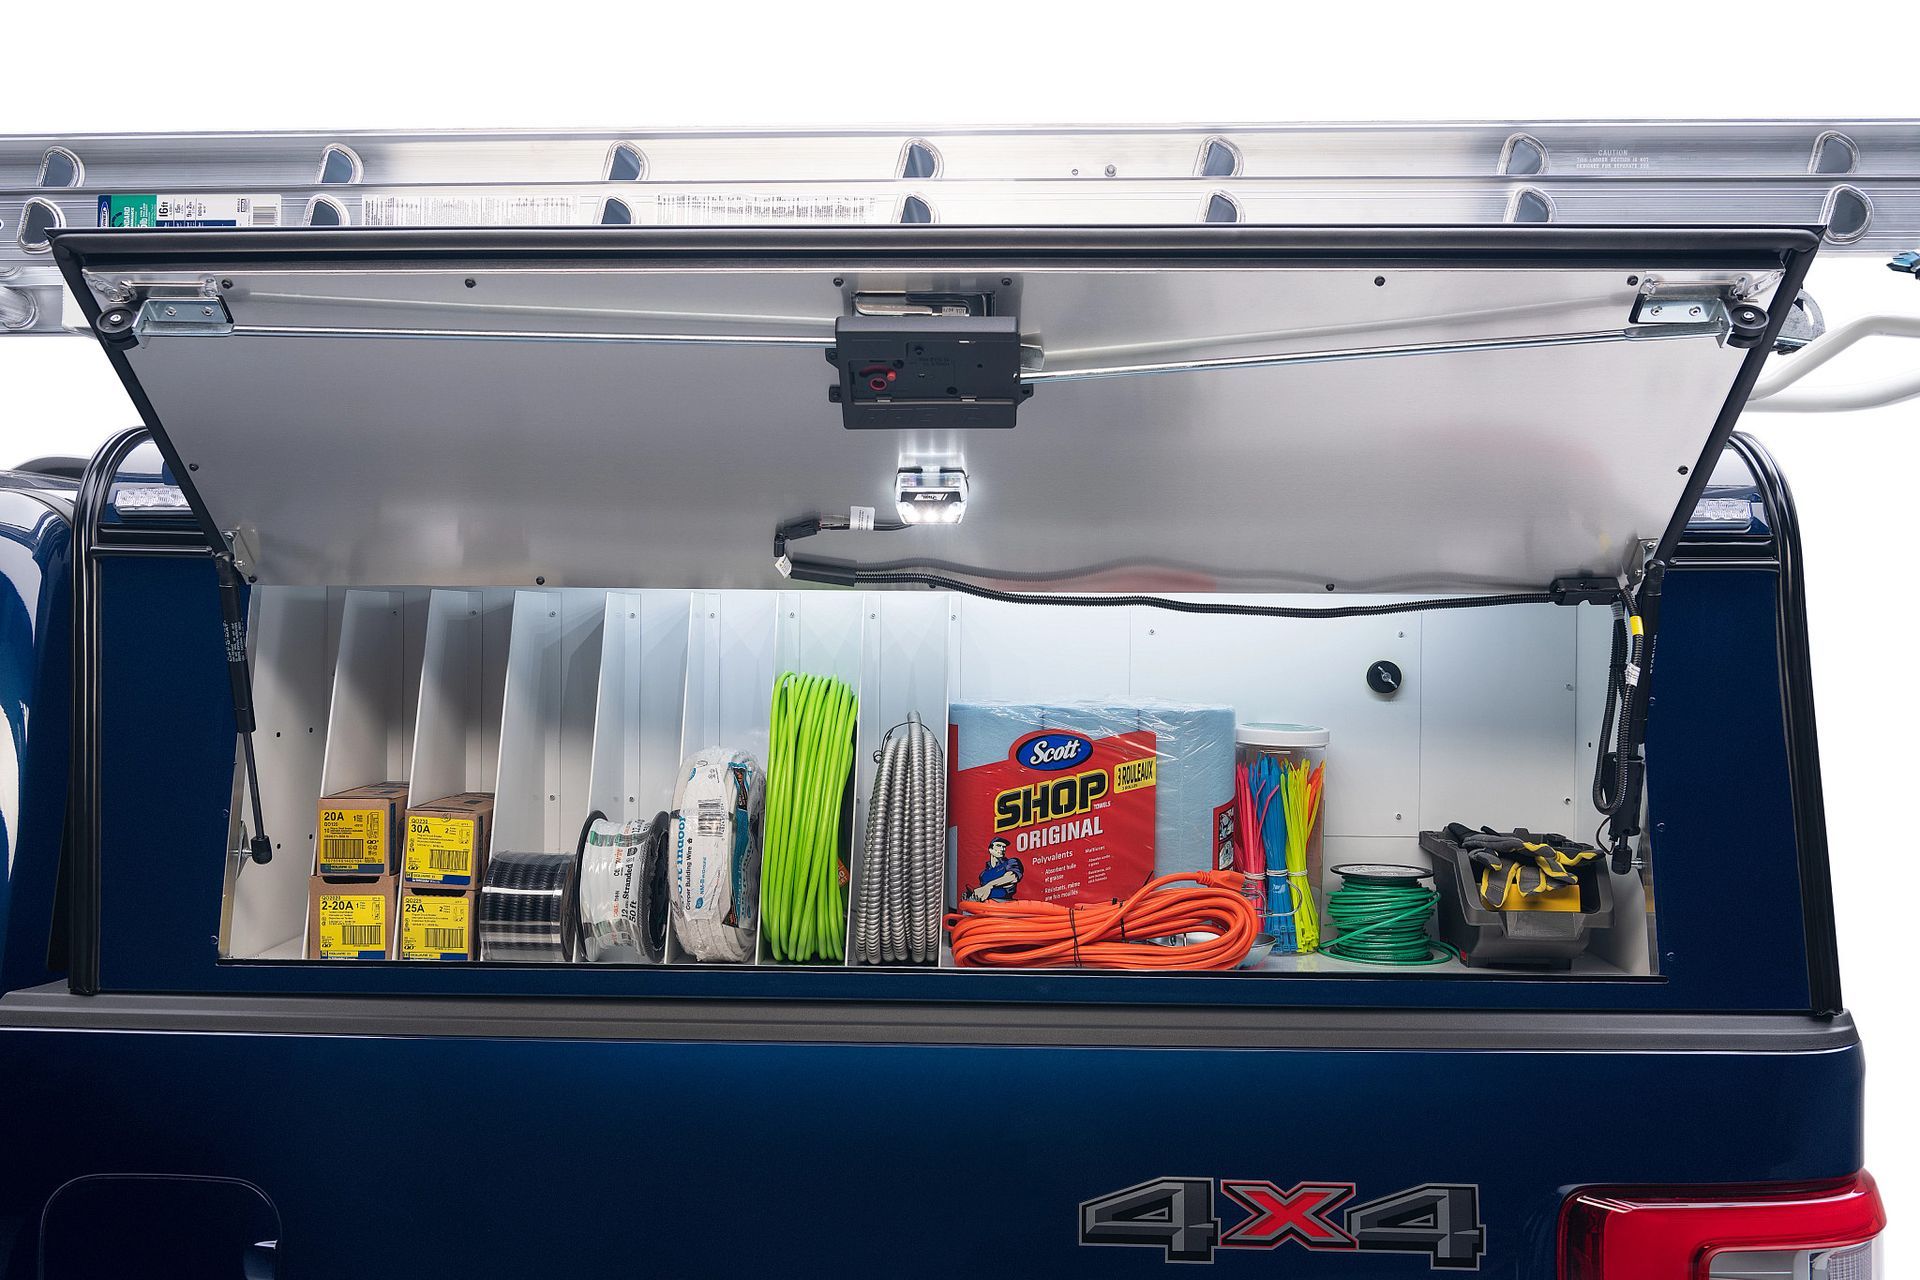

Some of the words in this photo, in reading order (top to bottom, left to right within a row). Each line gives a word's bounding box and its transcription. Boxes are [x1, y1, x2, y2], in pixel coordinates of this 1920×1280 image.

[1030, 739, 1080, 765] Scott
[1122, 761, 1154, 786] ROULEAUX
[995, 769, 1109, 833] SHOP
[324, 812, 345, 821] 20A
[411, 824, 431, 834] 30A
[1016, 816, 1104, 853] ORIGINAL
[1032, 850, 1074, 866] Polyvalents
[622, 864, 634, 900] Stranded
[685, 862, 693, 888] Building
[322, 901, 354, 911] 2-20A
[405, 904, 425, 913] 25A
[630, 900, 637, 909] ft
[621, 909, 629, 919] 12
[629, 910, 637, 923] 50
